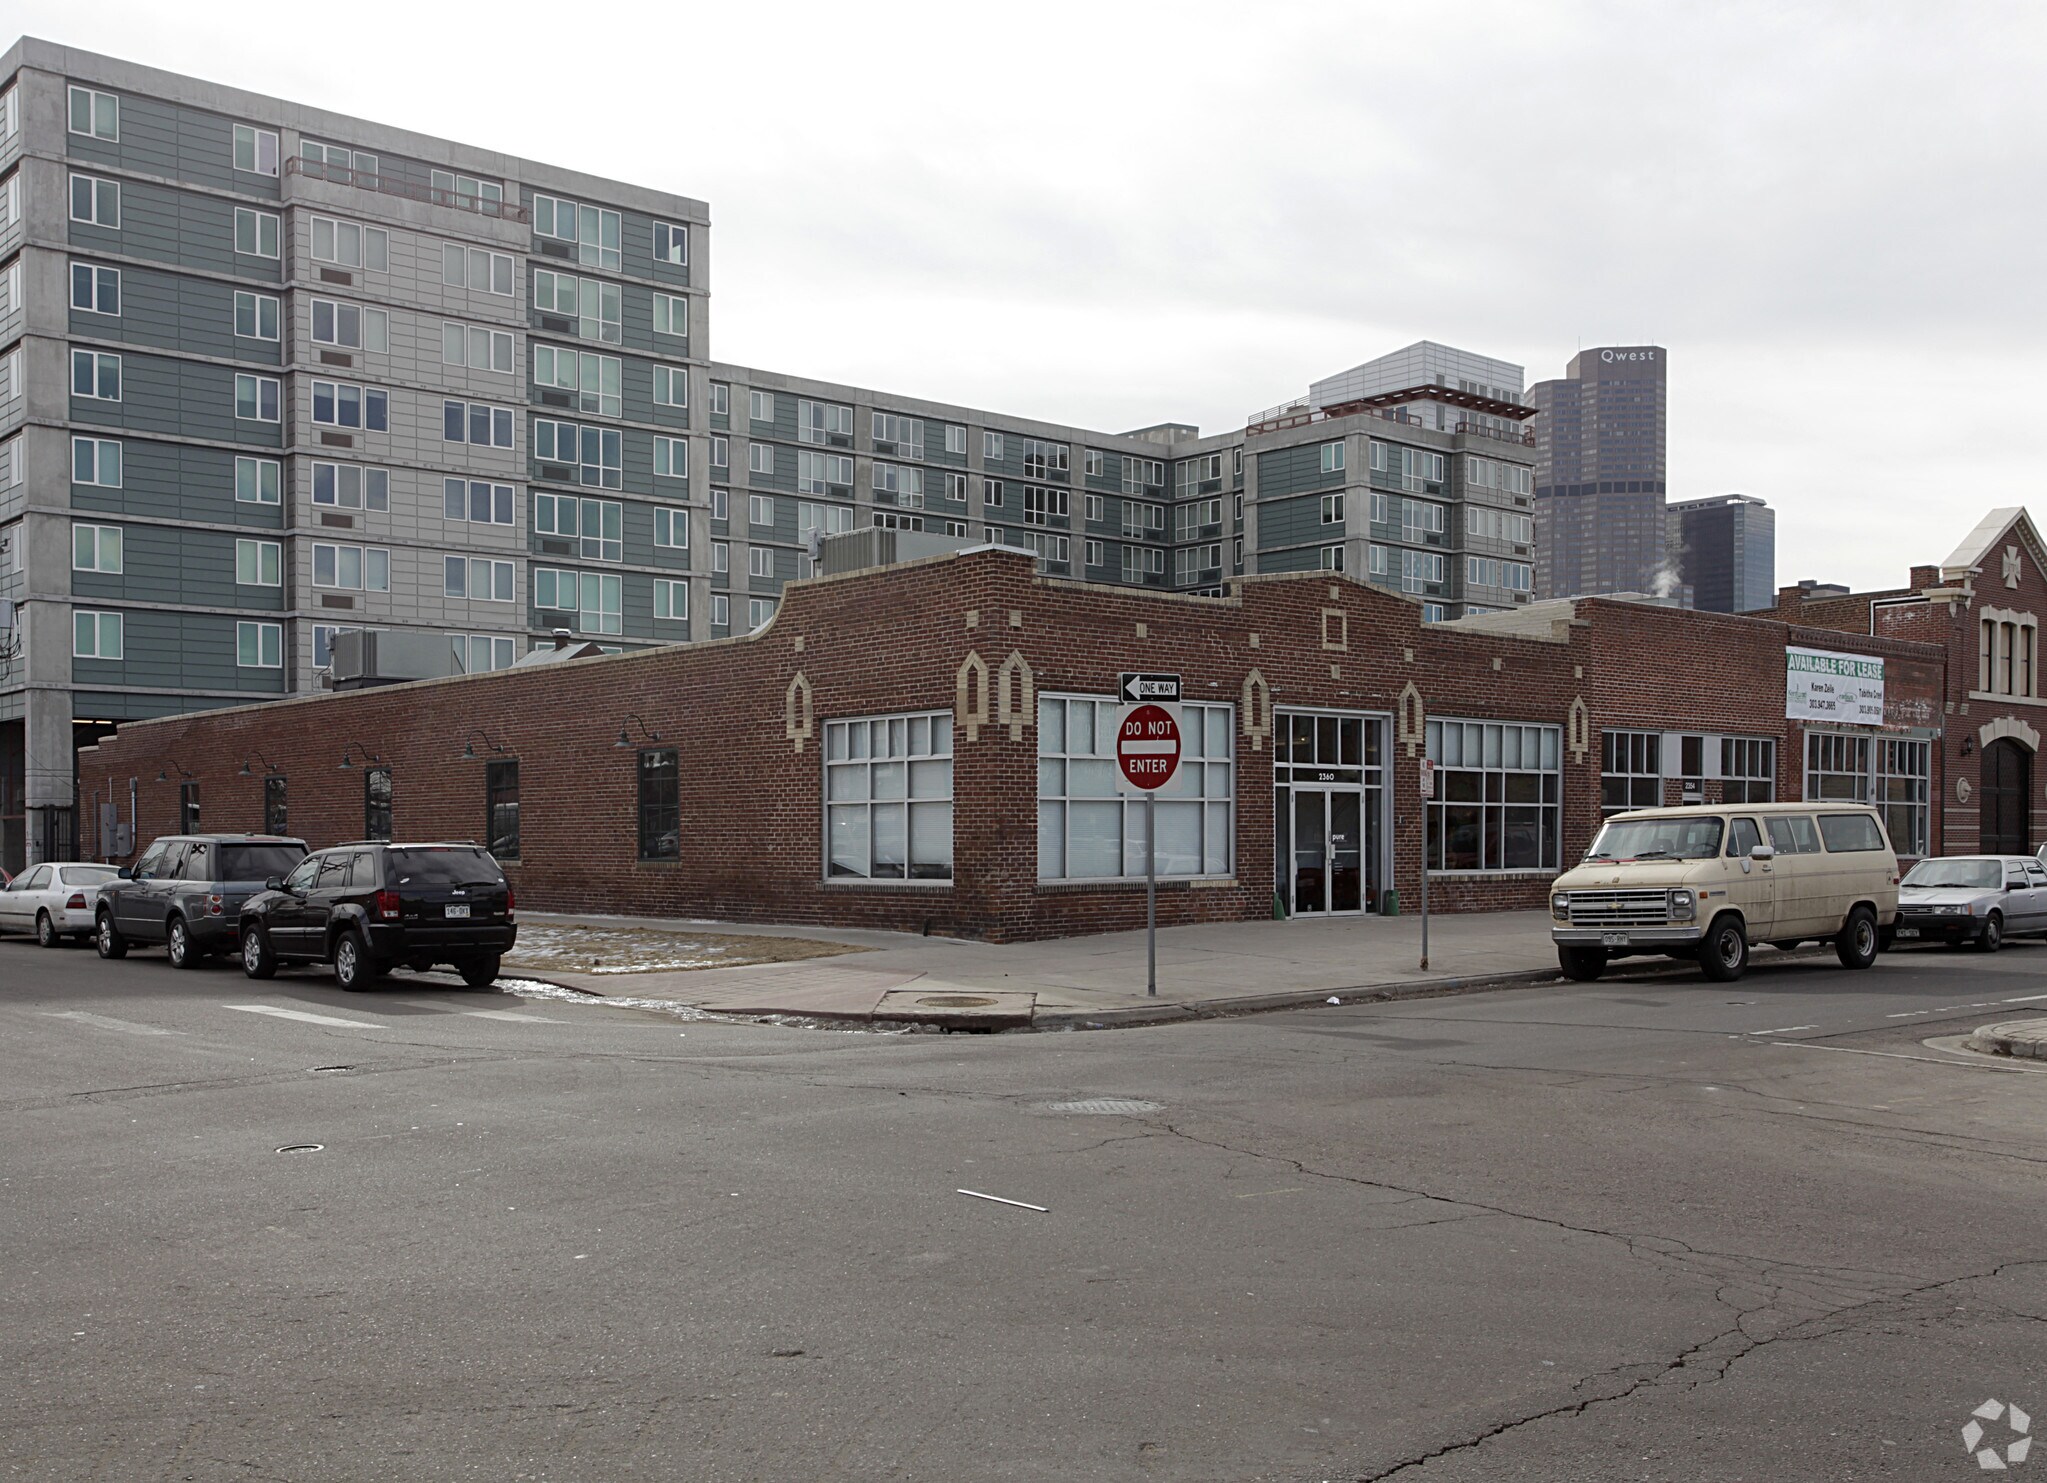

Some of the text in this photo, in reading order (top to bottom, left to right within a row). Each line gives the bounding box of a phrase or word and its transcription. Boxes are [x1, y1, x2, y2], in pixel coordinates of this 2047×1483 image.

[1601, 349, 1654, 363] Qwest
[1788, 654, 1882, 680] AVAILABLE FOR LEASE
[1140, 682, 1174, 694] ONE WAY
[1811, 682, 1823, 692] Karen
[1126, 721, 1172, 735] DO NOT
[1129, 759, 1167, 773] ENTER
[1319, 773, 1334, 781] 2360
[1332, 834, 1345, 842] pure
